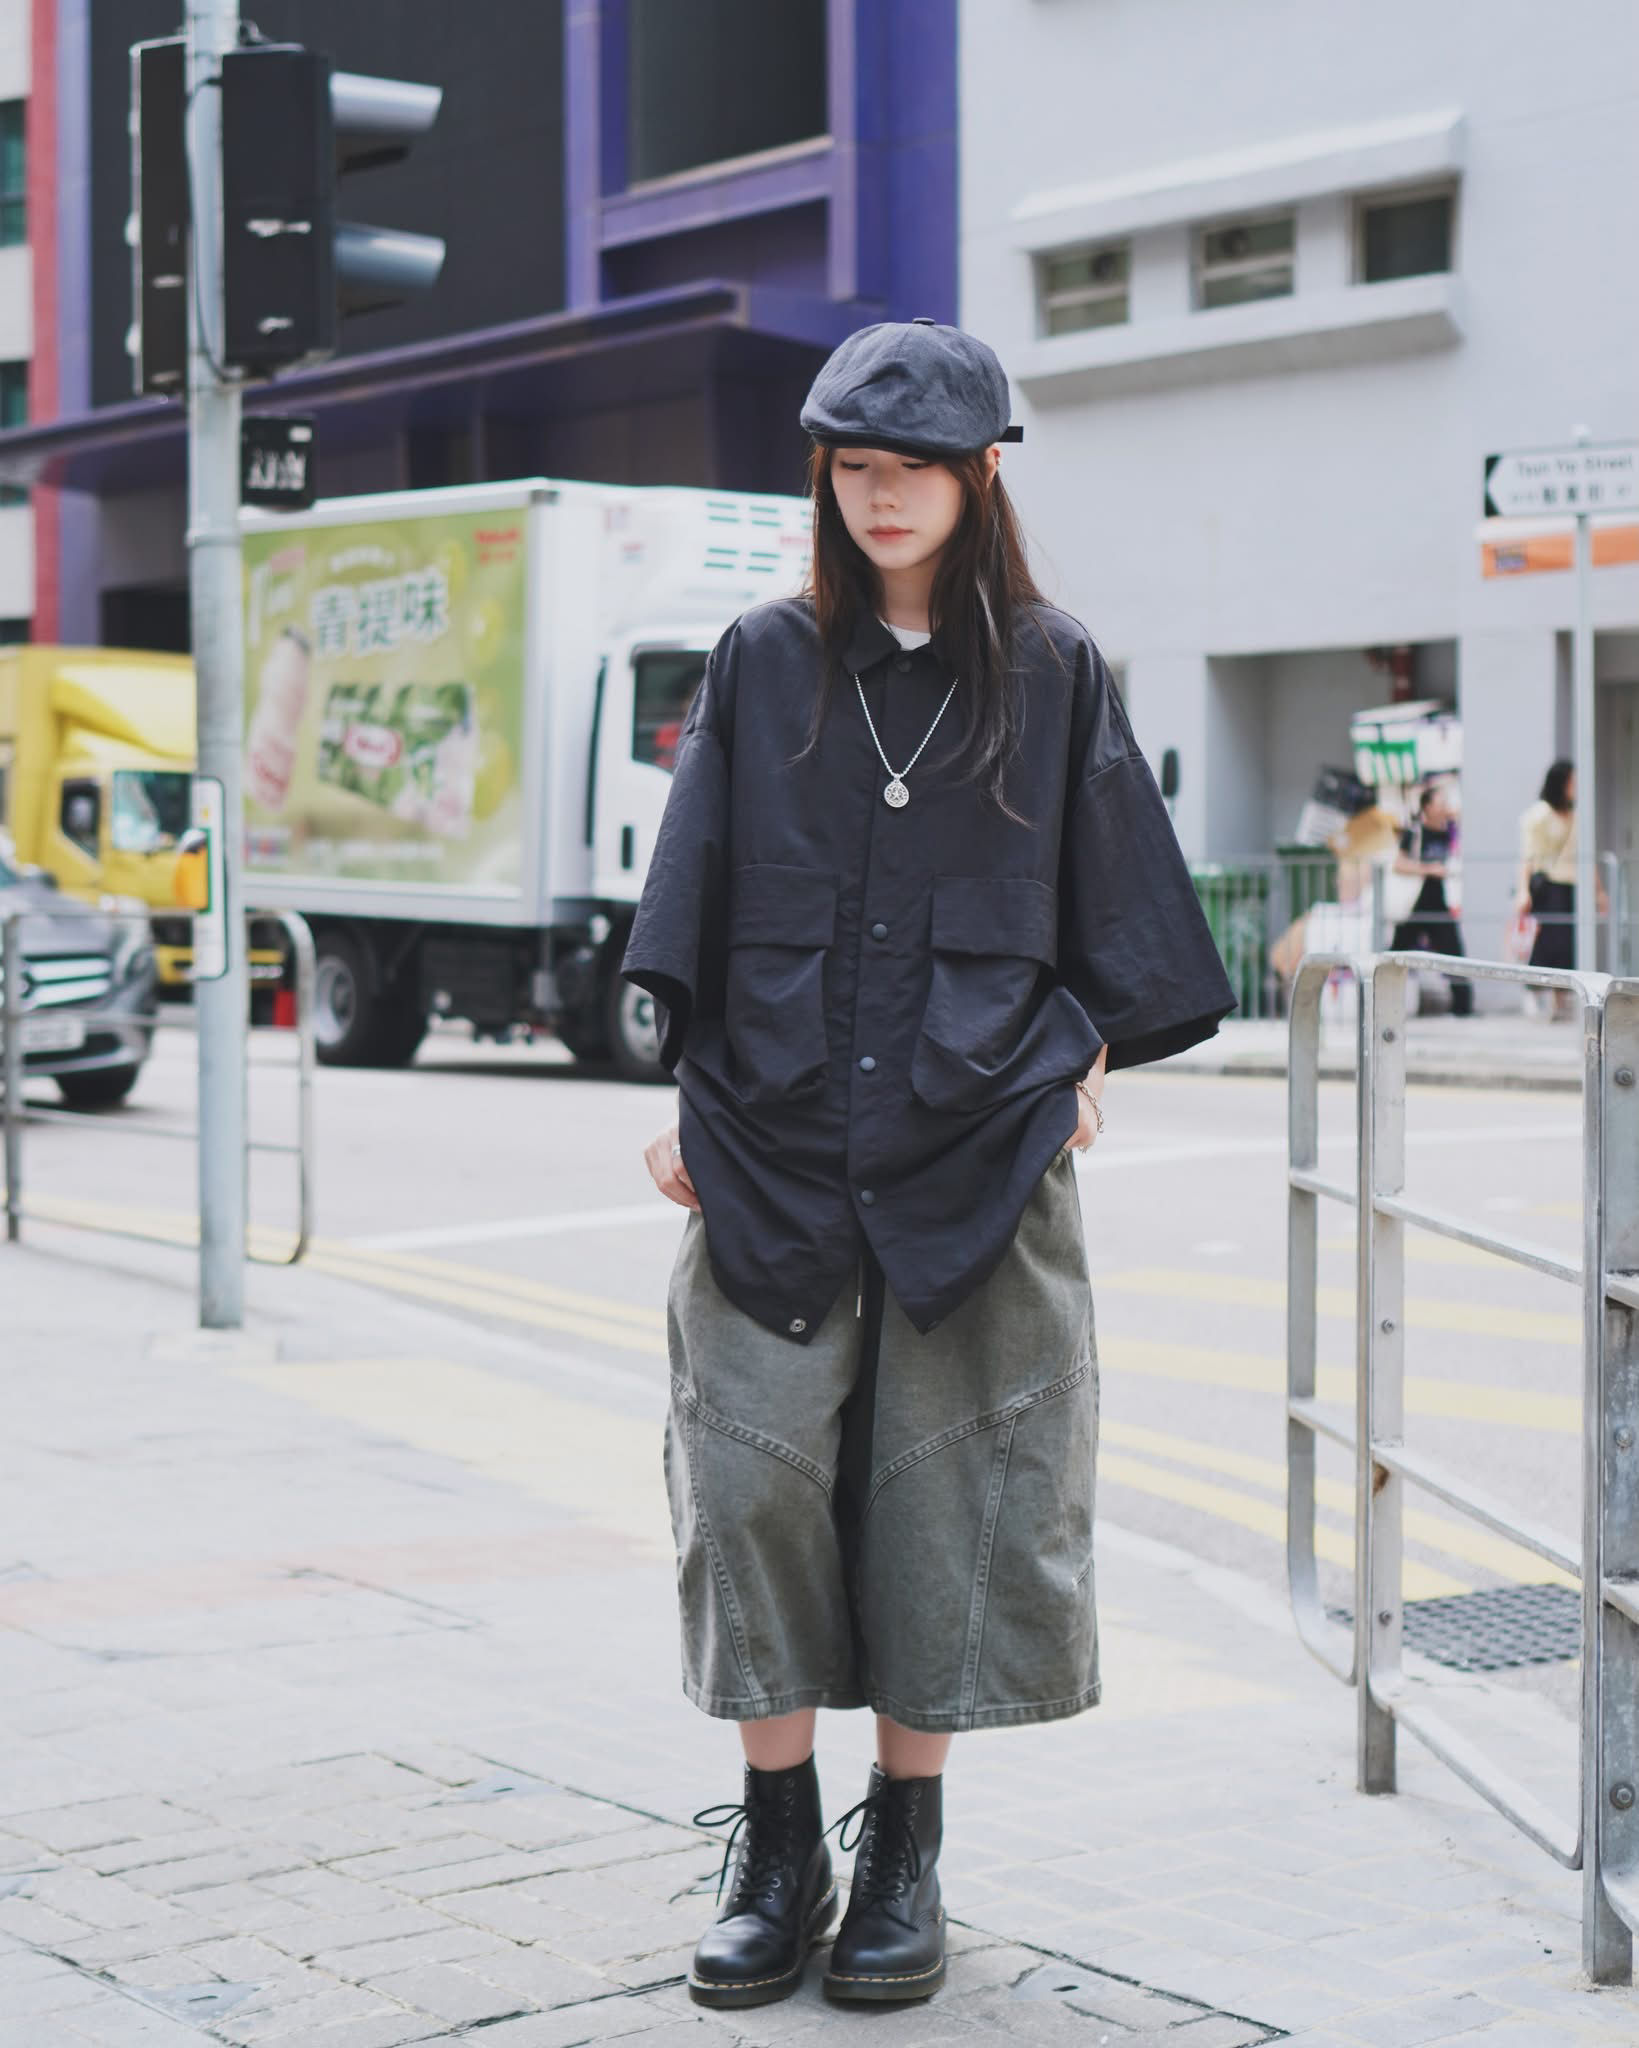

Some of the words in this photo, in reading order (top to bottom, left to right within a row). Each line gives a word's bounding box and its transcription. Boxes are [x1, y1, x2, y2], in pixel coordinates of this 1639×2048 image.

[1585, 455, 1633, 470] Street
[314, 575, 447, 654] 青提味
